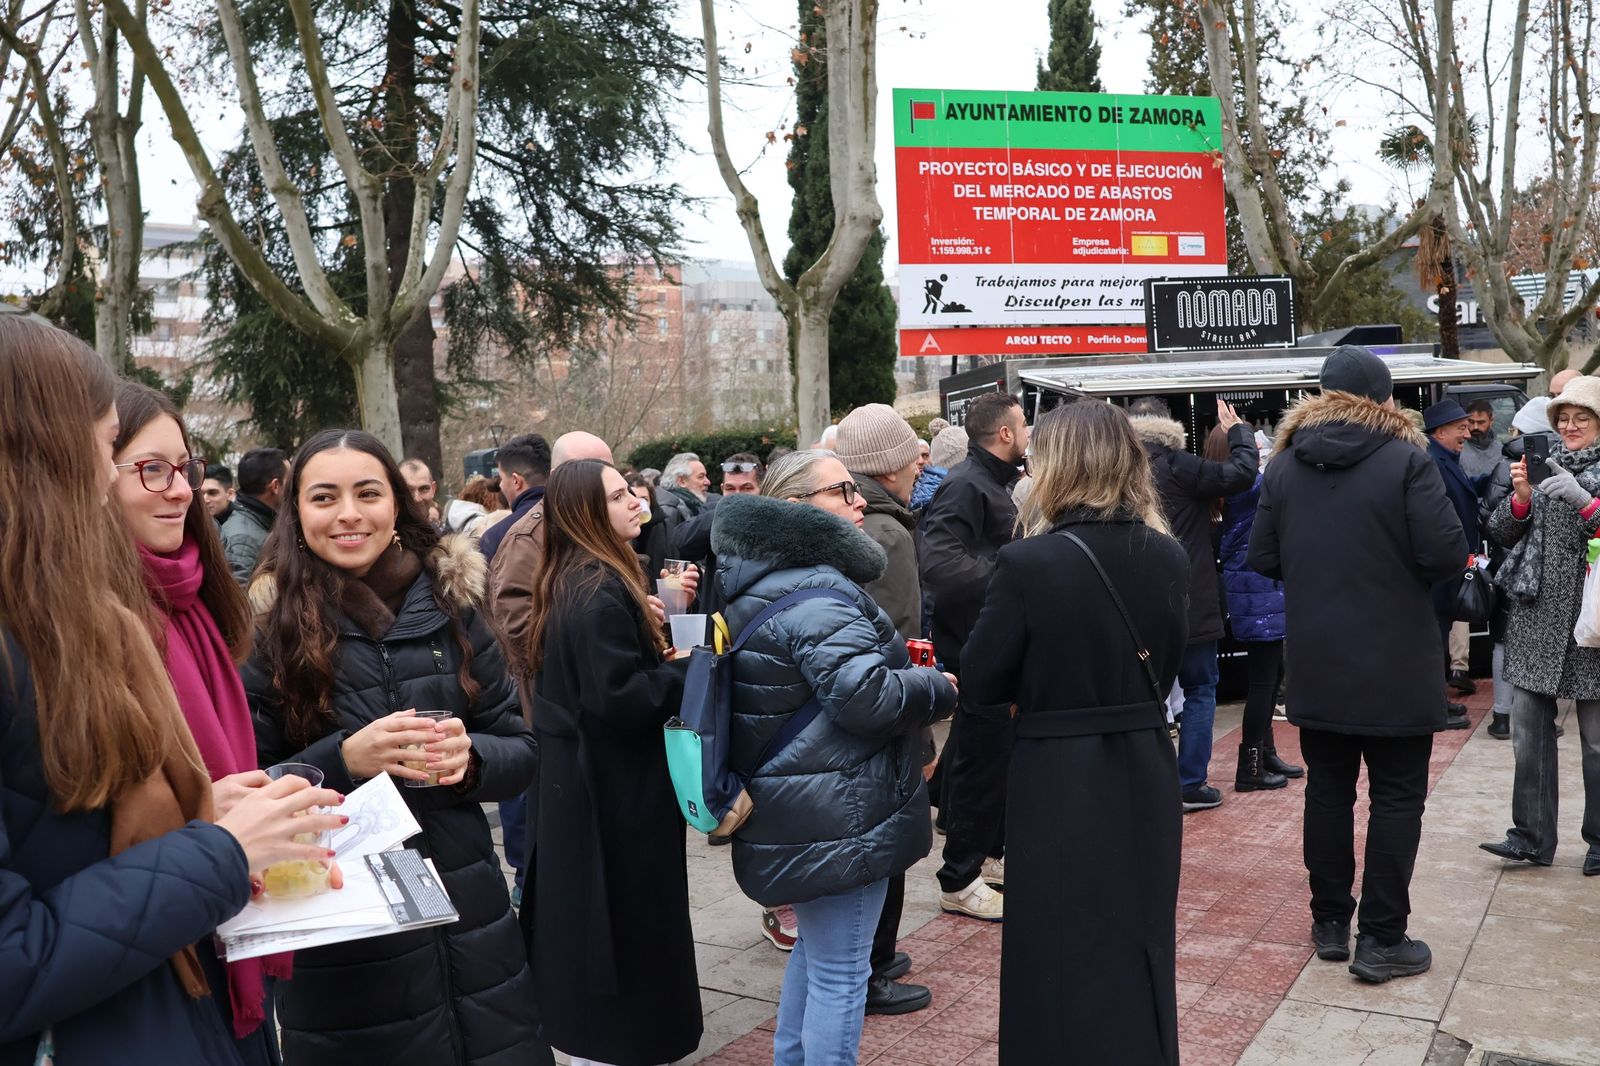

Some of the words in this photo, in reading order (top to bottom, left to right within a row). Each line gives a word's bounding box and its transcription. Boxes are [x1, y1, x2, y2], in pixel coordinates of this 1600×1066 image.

[945, 102, 1092, 123] AYUNTAMIENTO
[1098, 106, 1123, 124] DE
[1129, 107, 1206, 127] ZAMORA
[919, 161, 1008, 176] PROYECTO
[1012, 159, 1073, 177] BÁSICO
[1076, 163, 1087, 177] Y
[1091, 164, 1112, 178] DE
[1116, 163, 1203, 180] EJECUCIÓN
[953, 184, 986, 198] DEL
[989, 184, 1070, 199] MERCADO
[1074, 185, 1095, 199] DE
[1099, 186, 1173, 201] ABASTOS
[972, 206, 1061, 221] TEMPORAL
[1065, 207, 1087, 221] DE
[1090, 207, 1157, 222] ZAMORA
[931, 237, 975, 246] Inversión:
[1072, 237, 1110, 247] Empresa
[984, 246, 991, 255] €
[1072, 247, 1129, 256] adjudicataria:
[975, 275, 1057, 290] Trabajamos
[1061, 278, 1094, 290] para
[1004, 294, 1092, 309] Disculpen
[1098, 294, 1124, 307] las
[1087, 334, 1122, 344] Porfirio
[1200, 330, 1234, 344] STREET
[1239, 328, 1257, 342] BAR
